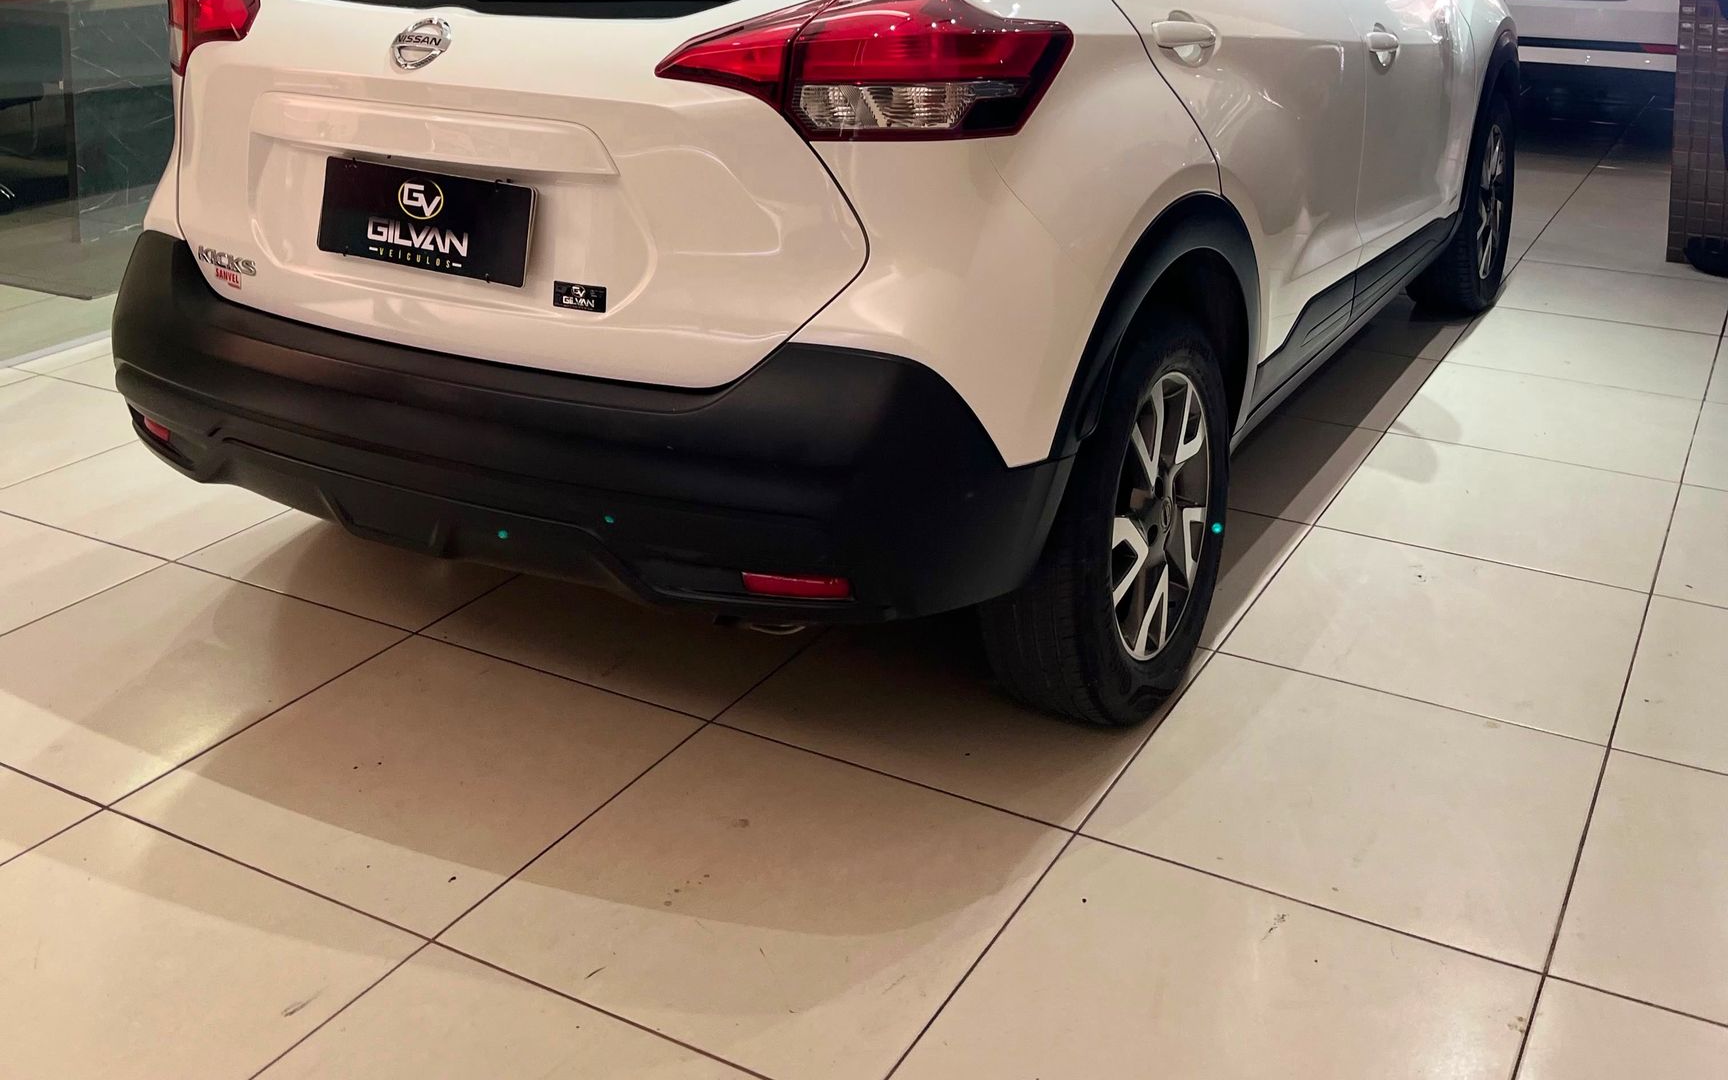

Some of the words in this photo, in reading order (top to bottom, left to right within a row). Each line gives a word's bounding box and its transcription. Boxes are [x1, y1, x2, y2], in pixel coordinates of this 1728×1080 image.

[397, 34, 442, 46] NISSAN
[402, 183, 441, 217] GV
[367, 217, 469, 258] GILVAN
[198, 245, 257, 276] KICKS
[562, 296, 595, 308] GILVAN
